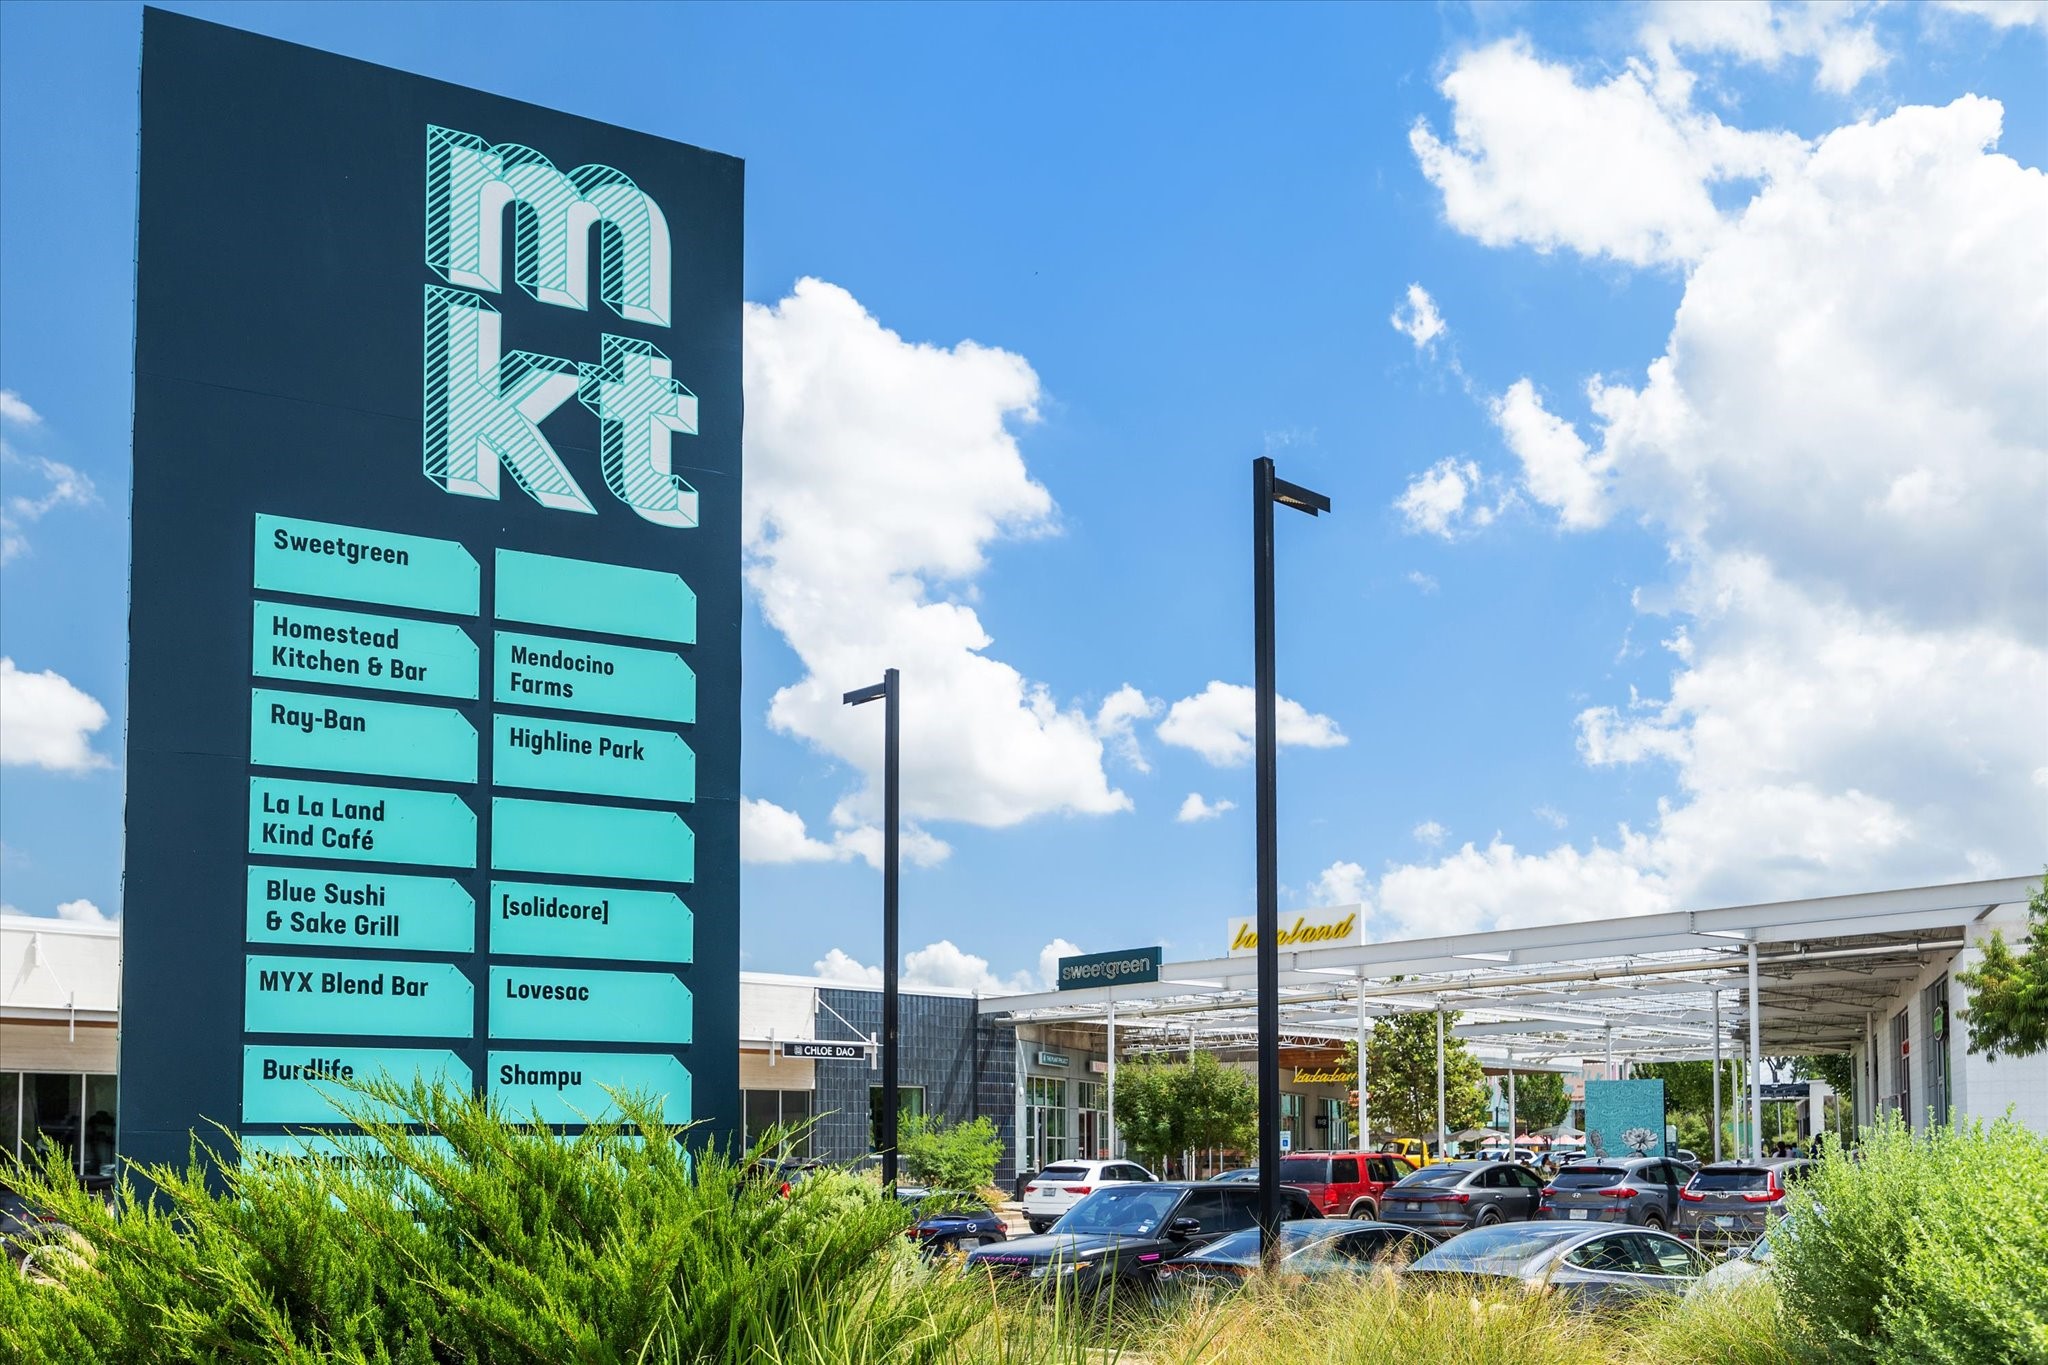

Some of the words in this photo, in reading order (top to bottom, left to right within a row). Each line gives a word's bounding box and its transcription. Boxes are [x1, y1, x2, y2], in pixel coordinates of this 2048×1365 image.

[273, 529, 409, 566] Sweetgreen
[272, 615, 399, 650] Homestead
[272, 645, 360, 675] Kitchen
[368, 656, 383, 676] &
[390, 658, 427, 682] Bar
[511, 645, 615, 676] Mendocino
[510, 671, 574, 698] Farms
[271, 703, 366, 733] Ray-Ban
[510, 727, 592, 756] Highline
[599, 736, 645, 761] Park
[263, 792, 290, 816] La
[298, 795, 324, 818] La
[332, 797, 385, 822] Land
[262, 822, 314, 848] Kind
[321, 826, 375, 851] Café
[266, 879, 316, 903] Blue
[324, 882, 386, 907] Sushi
[266, 910, 283, 931] &
[290, 911, 347, 935] Sake
[354, 914, 399, 937] Grill
[502, 894, 609, 925] [solidcore]
[1231, 912, 1356, 950] laaland
[1062, 957, 1150, 980] sweetgreen
[259, 970, 314, 993] MYX
[321, 972, 384, 996] Blend
[391, 976, 429, 997] Bar
[506, 978, 590, 1002] Lovesac
[804, 1045, 833, 1056] CHLOE
[836, 1047, 855, 1057] DAO
[263, 1059, 354, 1081] Burdlife
[499, 1064, 582, 1090] Shampu
